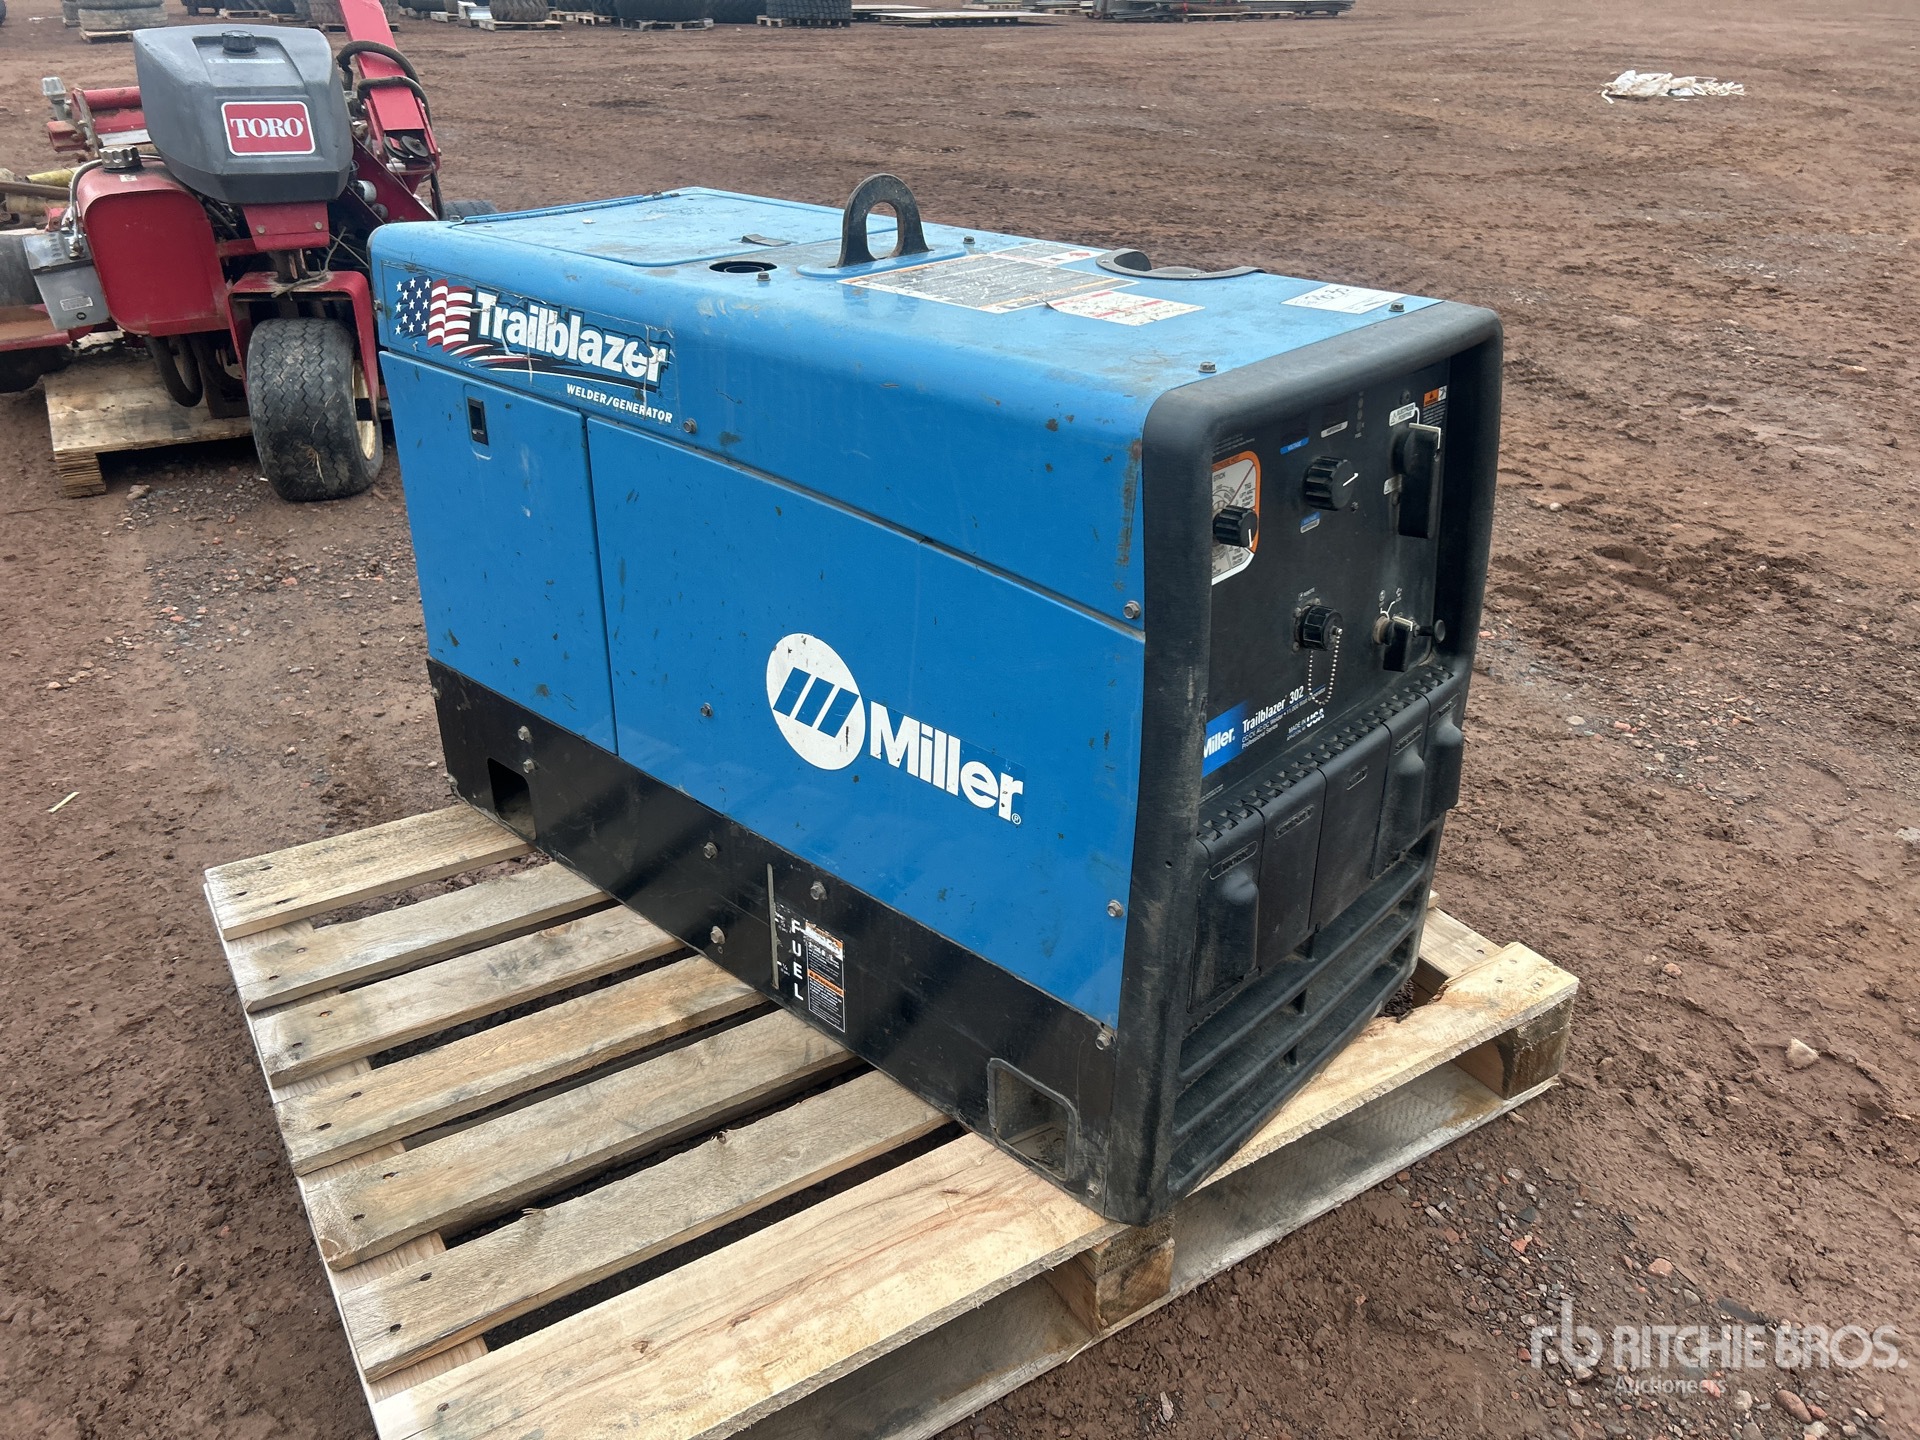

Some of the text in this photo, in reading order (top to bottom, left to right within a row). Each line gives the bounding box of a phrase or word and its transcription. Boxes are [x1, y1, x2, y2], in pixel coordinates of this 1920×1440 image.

[230, 118, 304, 138] TORO
[475, 291, 671, 383] Trailblazer
[566, 383, 673, 424] WELDER/GENERATOR
[1242, 685, 1304, 733] Trailblazer 302
[1306, 707, 1326, 728] USA
[870, 701, 1024, 822] Miller
[790, 918, 804, 1001] FUEL
